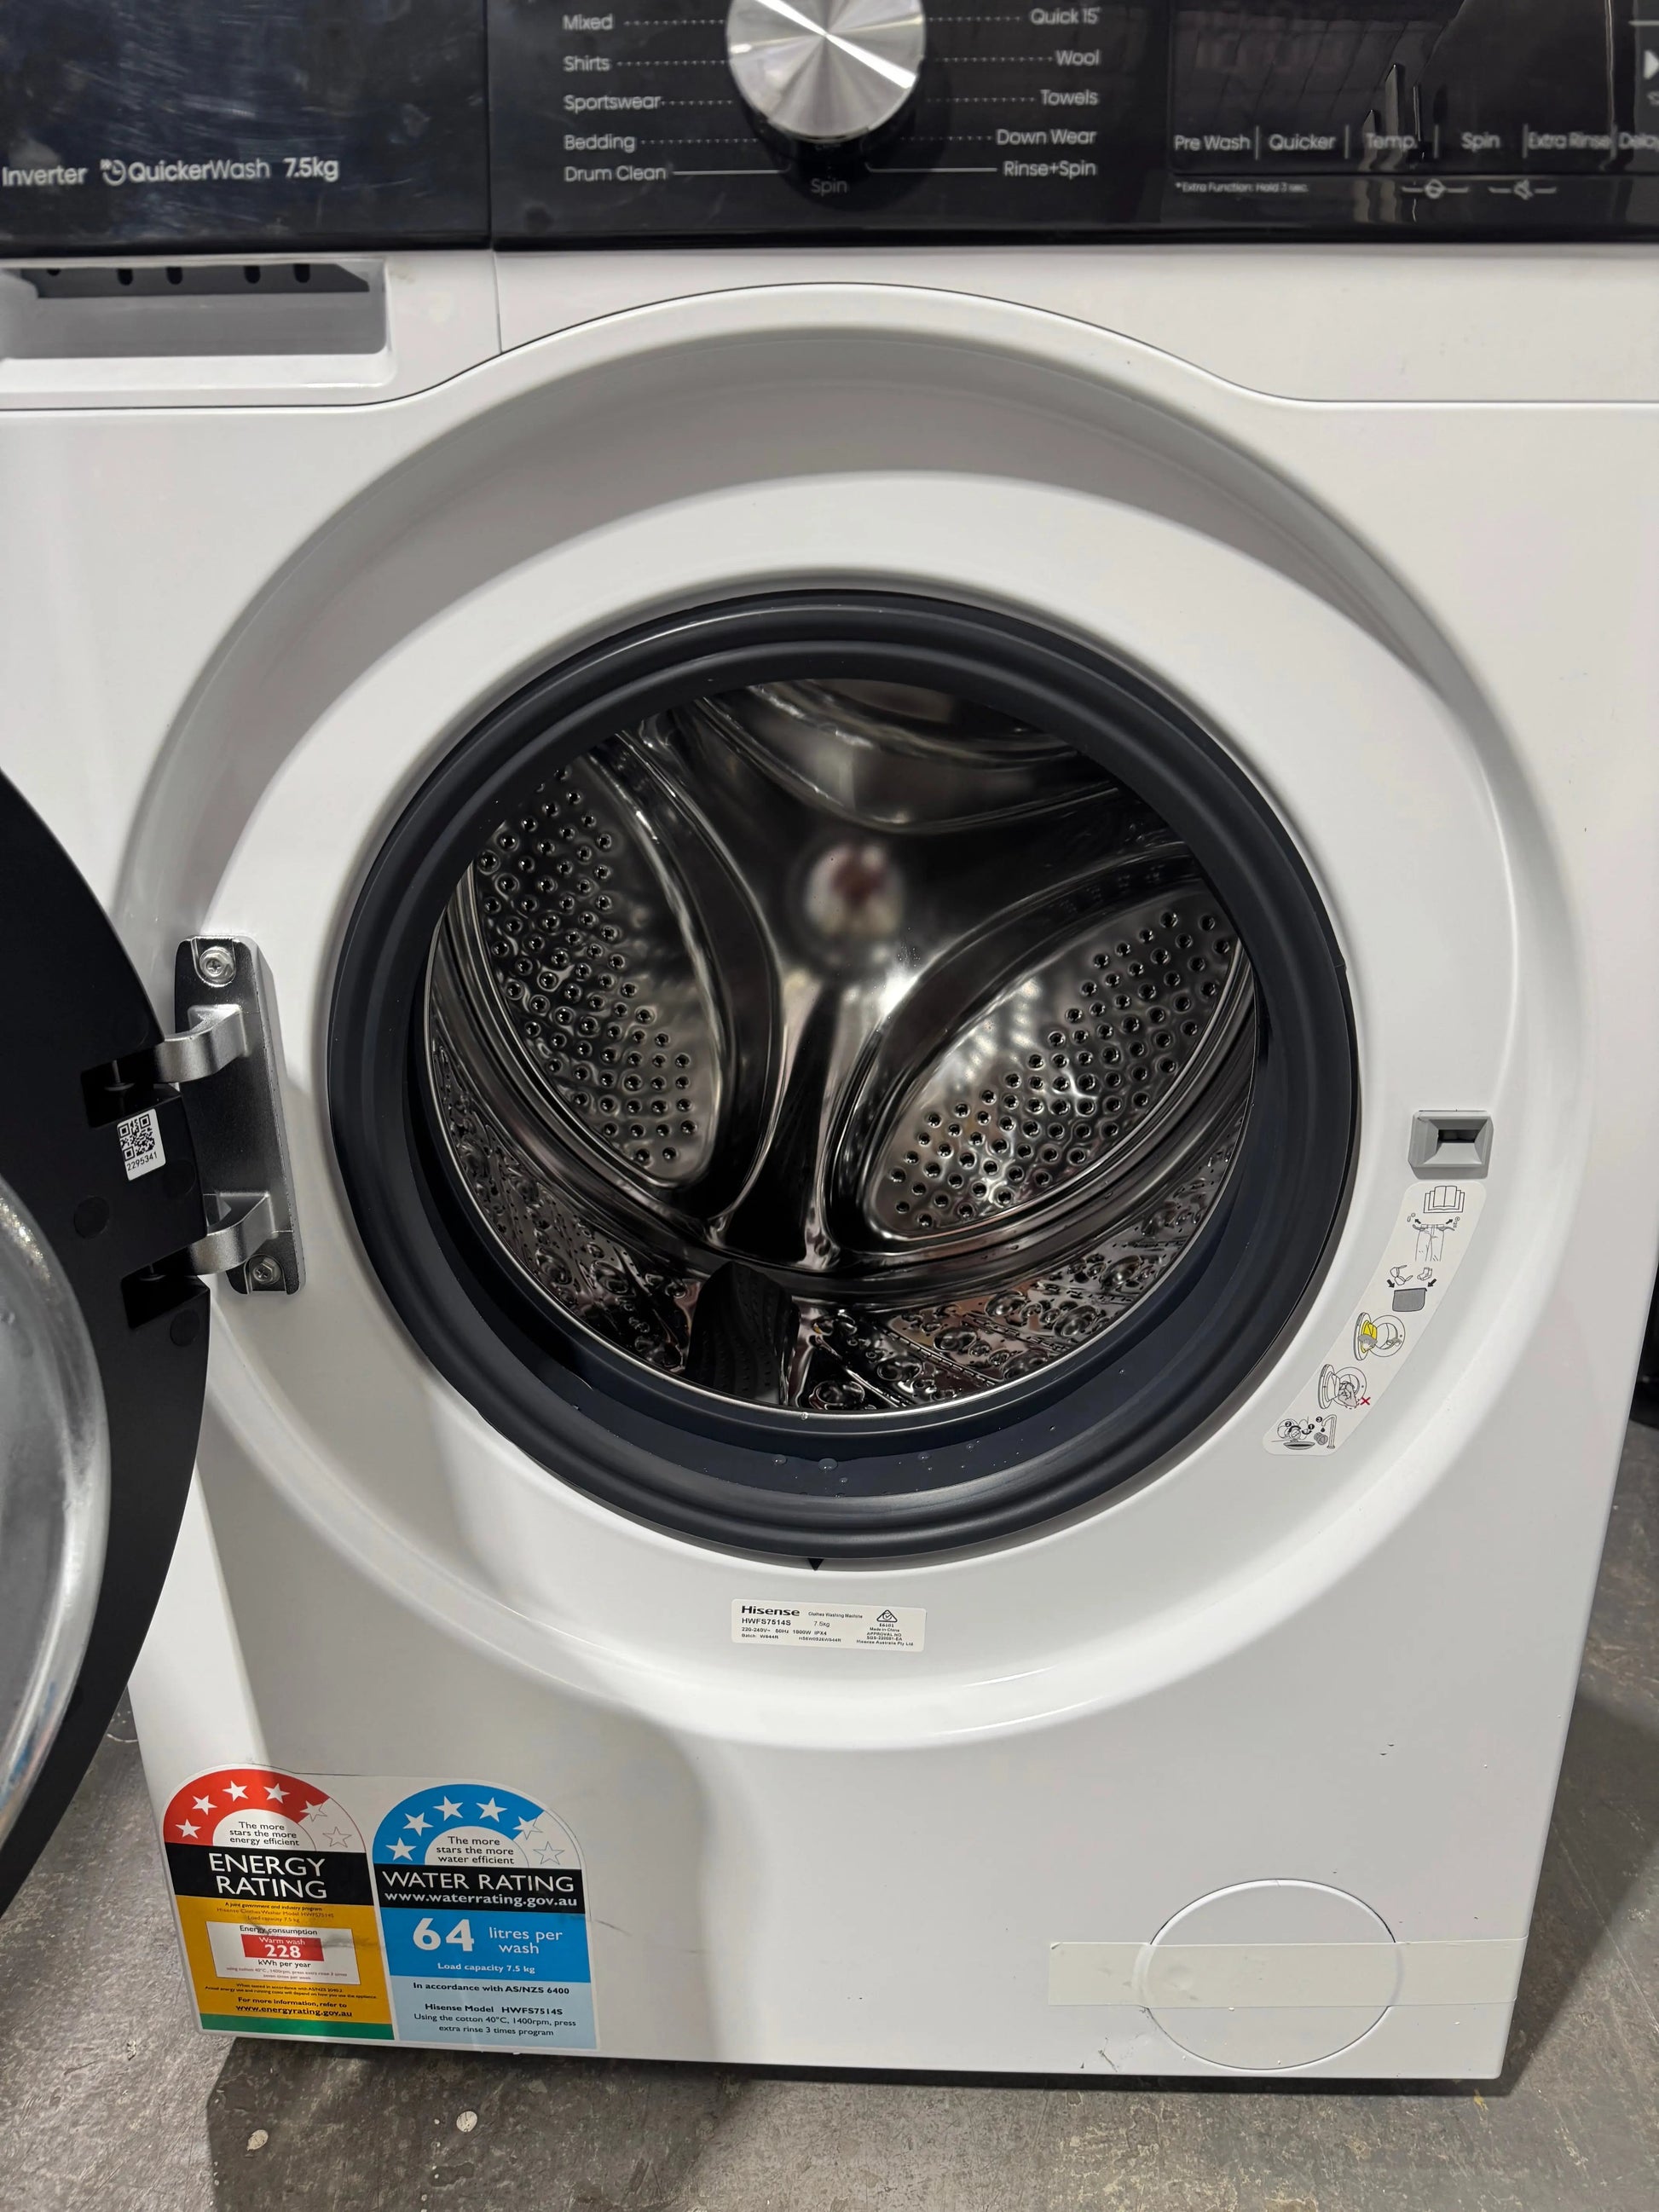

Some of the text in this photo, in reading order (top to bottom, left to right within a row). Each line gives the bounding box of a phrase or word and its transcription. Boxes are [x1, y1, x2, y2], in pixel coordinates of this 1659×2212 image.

[563, 14, 614, 31] Mixed
[1030, 8, 1078, 25] Quick
[564, 55, 611, 72] Shirts
[1055, 49, 1101, 66] Wool
[564, 95, 662, 113] Sportswear
[1040, 89, 1099, 106] Towels
[564, 134, 636, 153] Bedding
[997, 129, 1097, 145] Down Wear
[1174, 135, 1251, 151] Pre Wash
[1269, 133, 1336, 151] Quicker
[1461, 131, 1501, 152] Spin
[1528, 131, 1567, 150] Extra
[2, 158, 339, 187] Inverter QuickerWash 7.5kg
[564, 165, 667, 182] Drum Clean
[1003, 160, 1098, 180] Rinse+Spin
[811, 177, 848, 197] Spin
[126, 1152, 158, 1171] 2295341
[741, 1605, 801, 1617] Hisense
[229, 1828, 251, 1837] stars
[254, 1829, 269, 1838] the
[239, 1821, 257, 1829] The
[229, 1837, 300, 1846] energy efficient
[448, 1836, 470, 1845] The
[436, 1845, 462, 1854] stars
[465, 1846, 483, 1855] the
[208, 1852, 326, 1877] ENERGY
[471, 1855, 515, 1864] efficient
[216, 1875, 327, 1899] RATING
[383, 1871, 575, 1892] WATER RATING
[384, 1892, 577, 1908] www.waterrating.gov.au
[268, 1927, 318, 1936] consumption
[413, 1917, 475, 1952] 64
[489, 1926, 563, 1943] litres per
[259, 1936, 284, 1944] Warm
[264, 1943, 302, 1959] 228
[499, 1942, 540, 1955] wash
[437, 1962, 461, 1971] Load
[465, 1963, 504, 1973] capacity
[523, 1965, 535, 1974] kg
[425, 1983, 480, 1992] accordance
[482, 1984, 503, 1992] with
[505, 1985, 545, 1994] AS/NZS
[546, 1986, 569, 1995] 6400
[274, 1999, 318, 2007] information,
[425, 2003, 462, 2012] Hisense
[501, 2006, 564, 2015] HWFS7514S
[235, 2005, 352, 2018] www.energyrating.gov.au
[413, 2013, 437, 2022] Using
[455, 2014, 483, 2023] cotton
[512, 2017, 552, 2026] 1400rpm,
[554, 2019, 576, 2028] press
[439, 2024, 554, 2036] extra rinse 3 times program
